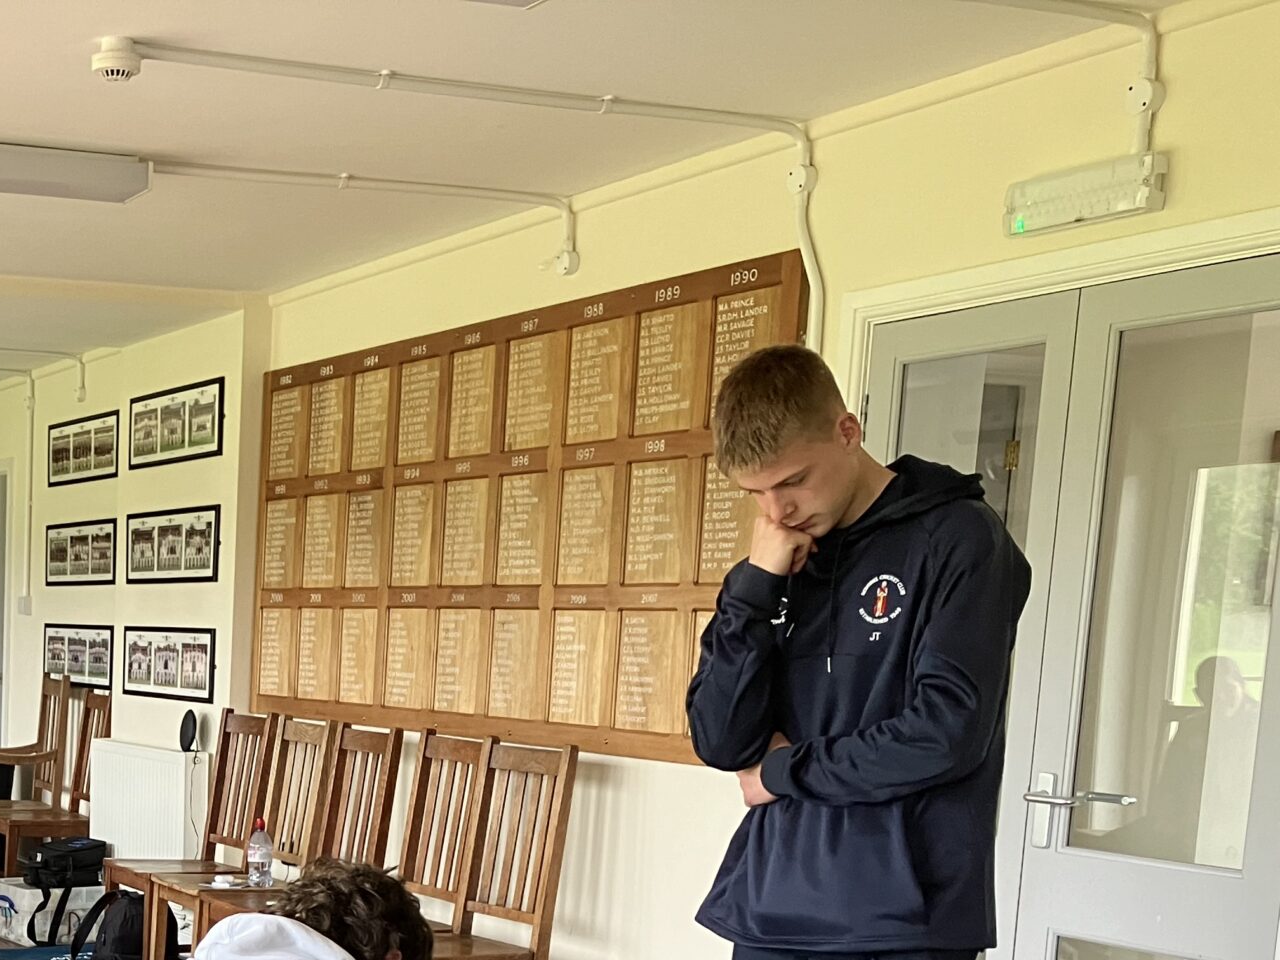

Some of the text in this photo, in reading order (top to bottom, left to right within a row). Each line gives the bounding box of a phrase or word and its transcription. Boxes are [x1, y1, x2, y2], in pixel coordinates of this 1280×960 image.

[730, 268, 758, 286] 1990
[655, 285, 680, 302] 1989
[731, 297, 754, 308] PRINCE
[584, 302, 603, 318] 1988
[740, 305, 768, 318] LANDER
[521, 318, 538, 332] 1987
[730, 318, 754, 330] SAVAGE
[464, 332, 480, 345] 1986
[732, 329, 754, 340] DAVIES
[411, 344, 427, 356] 1985
[725, 340, 749, 352] TAYLOR
[364, 355, 378, 367] 1984
[320, 365, 333, 376] 1983
[280, 374, 292, 385] 1982
[645, 440, 665, 453] 1998
[576, 448, 595, 461] 1997
[455, 462, 471, 473] 1995
[511, 456, 529, 467] 1996
[404, 469, 420, 479] 1994
[715, 531, 739, 539] LAMONT
[401, 593, 416, 603] 2003
[641, 594, 658, 603] 2007
[869, 632, 881, 641] JT
